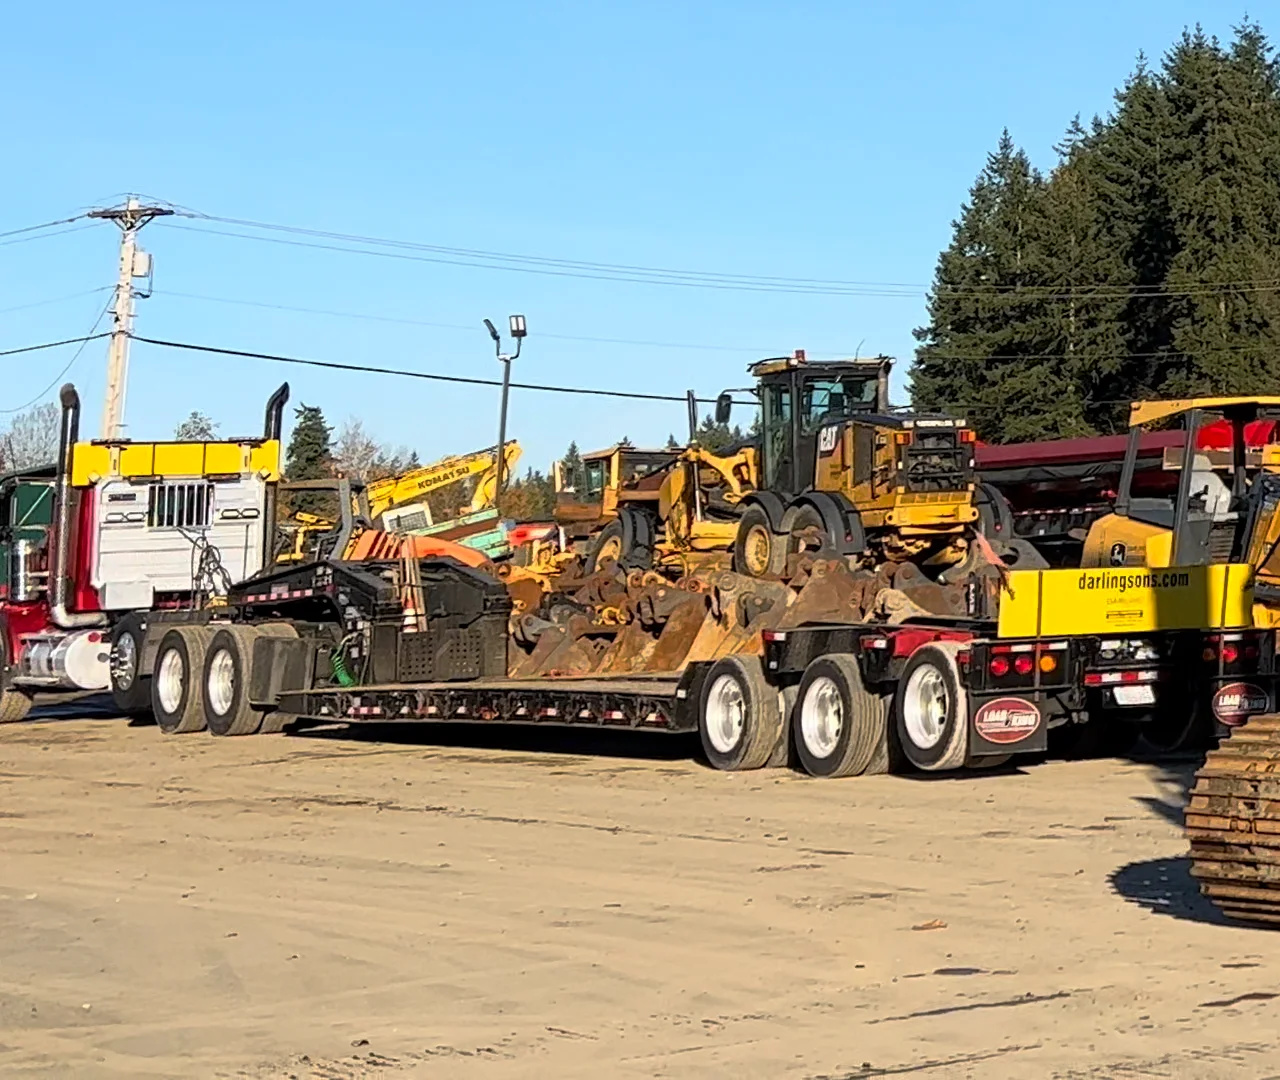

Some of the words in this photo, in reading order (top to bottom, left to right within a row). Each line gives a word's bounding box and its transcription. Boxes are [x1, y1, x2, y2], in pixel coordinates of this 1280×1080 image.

[819, 426, 839, 452] CAT
[417, 466, 470, 490] KOMATSU
[1078, 571, 1190, 593] darlingsons.com
[983, 709, 1007, 722] LOAD
[1010, 712, 1036, 726] KING
